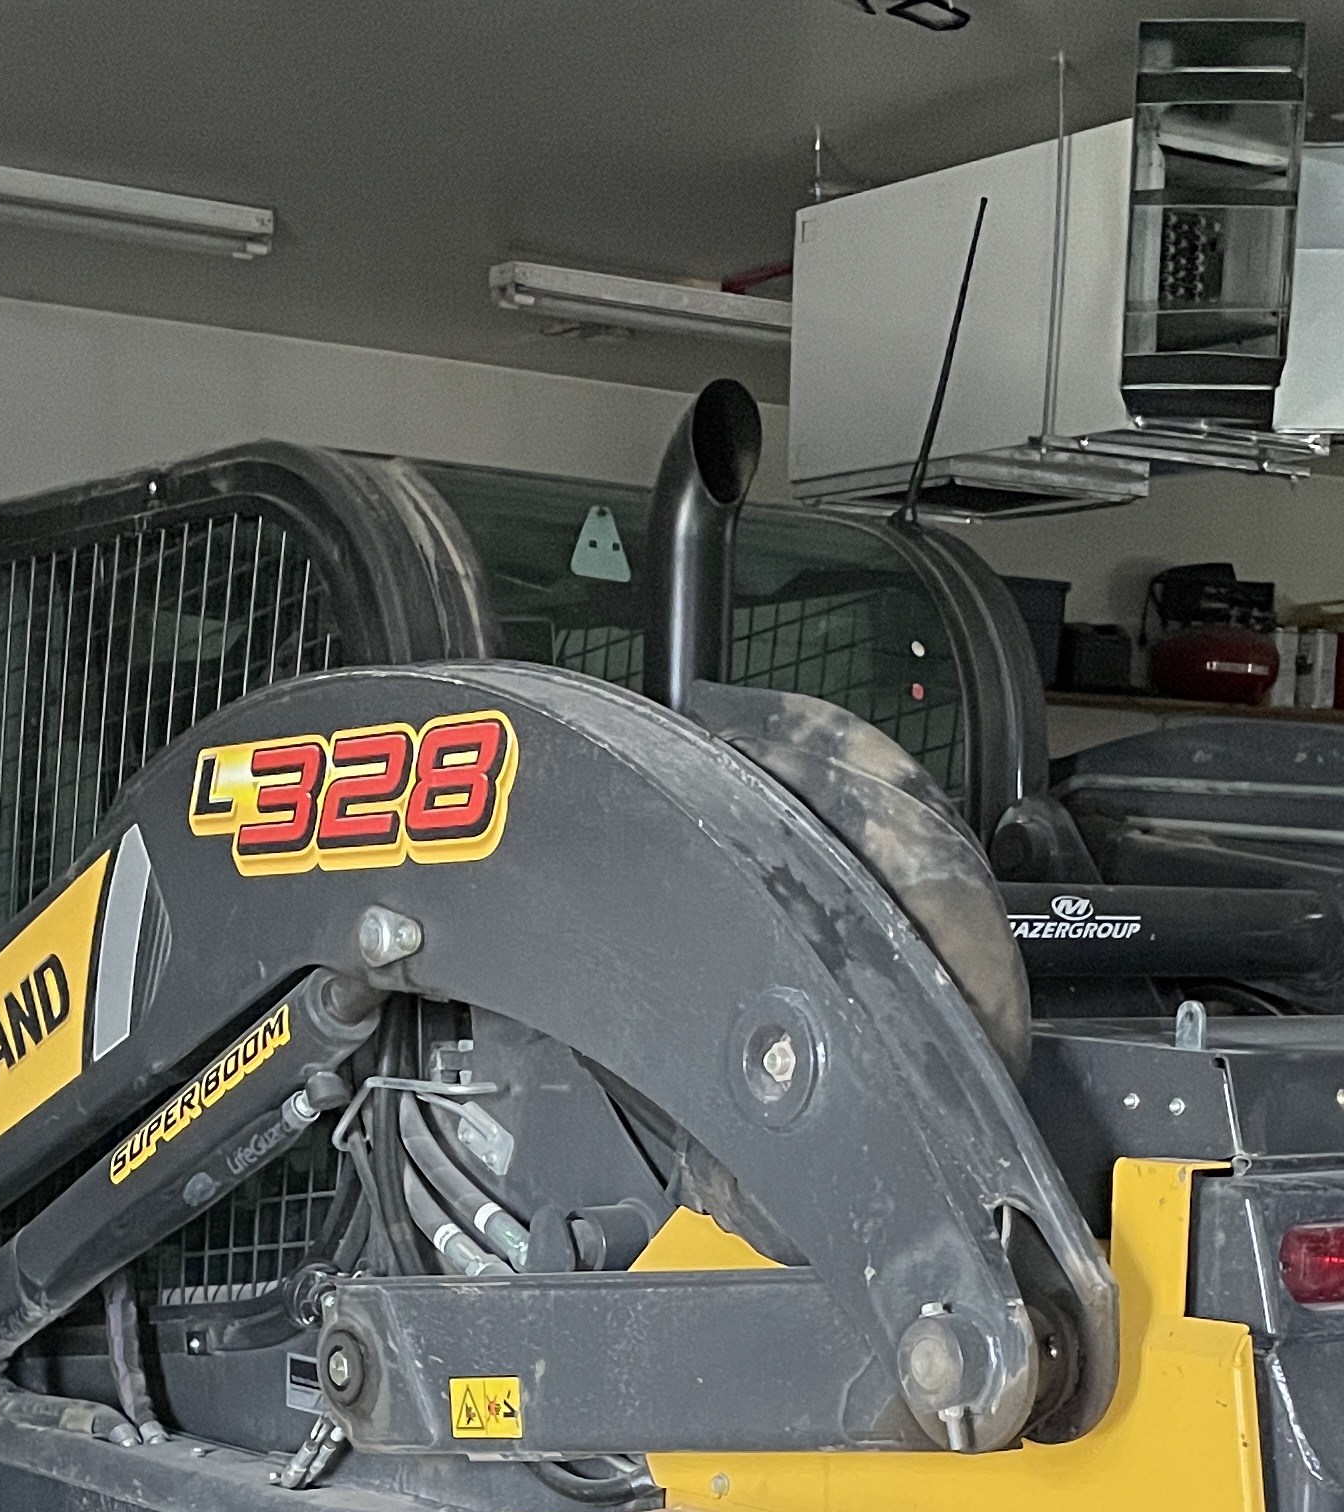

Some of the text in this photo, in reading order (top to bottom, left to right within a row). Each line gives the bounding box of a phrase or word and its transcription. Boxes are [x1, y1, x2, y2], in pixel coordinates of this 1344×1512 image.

[192, 716, 511, 860] L328
[112, 1006, 288, 1178] SUPER BOOM
